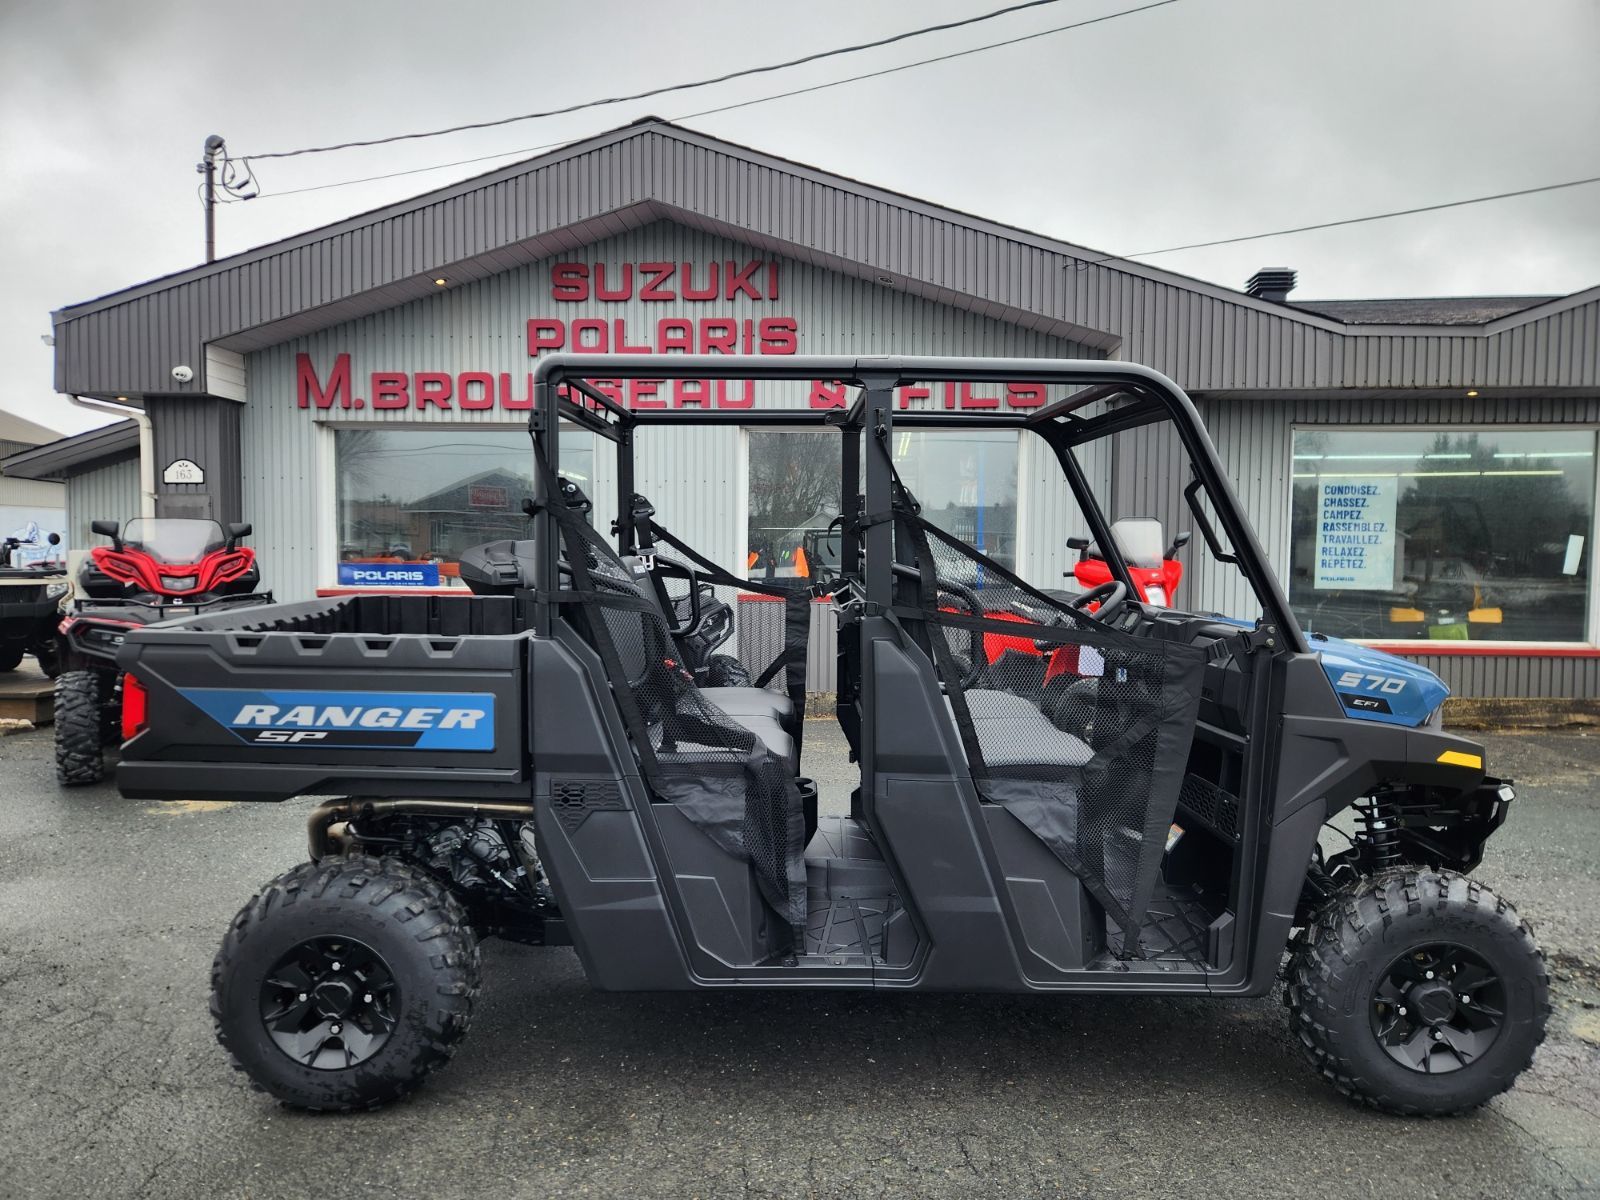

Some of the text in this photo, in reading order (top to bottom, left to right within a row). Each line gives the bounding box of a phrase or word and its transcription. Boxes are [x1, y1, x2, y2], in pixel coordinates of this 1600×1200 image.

[551, 260, 780, 302] SUZUKI
[527, 317, 798, 357] POLARIS
[1324, 485, 1381, 495] CONDUISEZ.
[1323, 498, 1369, 507] CHASSEZ.
[1323, 510, 1363, 519] CAMPEZ.
[1322, 522, 1387, 532] RASSEMBLEZ.
[1322, 535, 1382, 544] TRAVAILLEZ.
[1321, 547, 1367, 556] RELAXEZ.
[353, 571, 424, 580] POLARIS
[1336, 671, 1407, 694] 570
[1352, 699, 1380, 708] EFI
[233, 704, 485, 729] RANGER
[254, 730, 329, 743] SP
